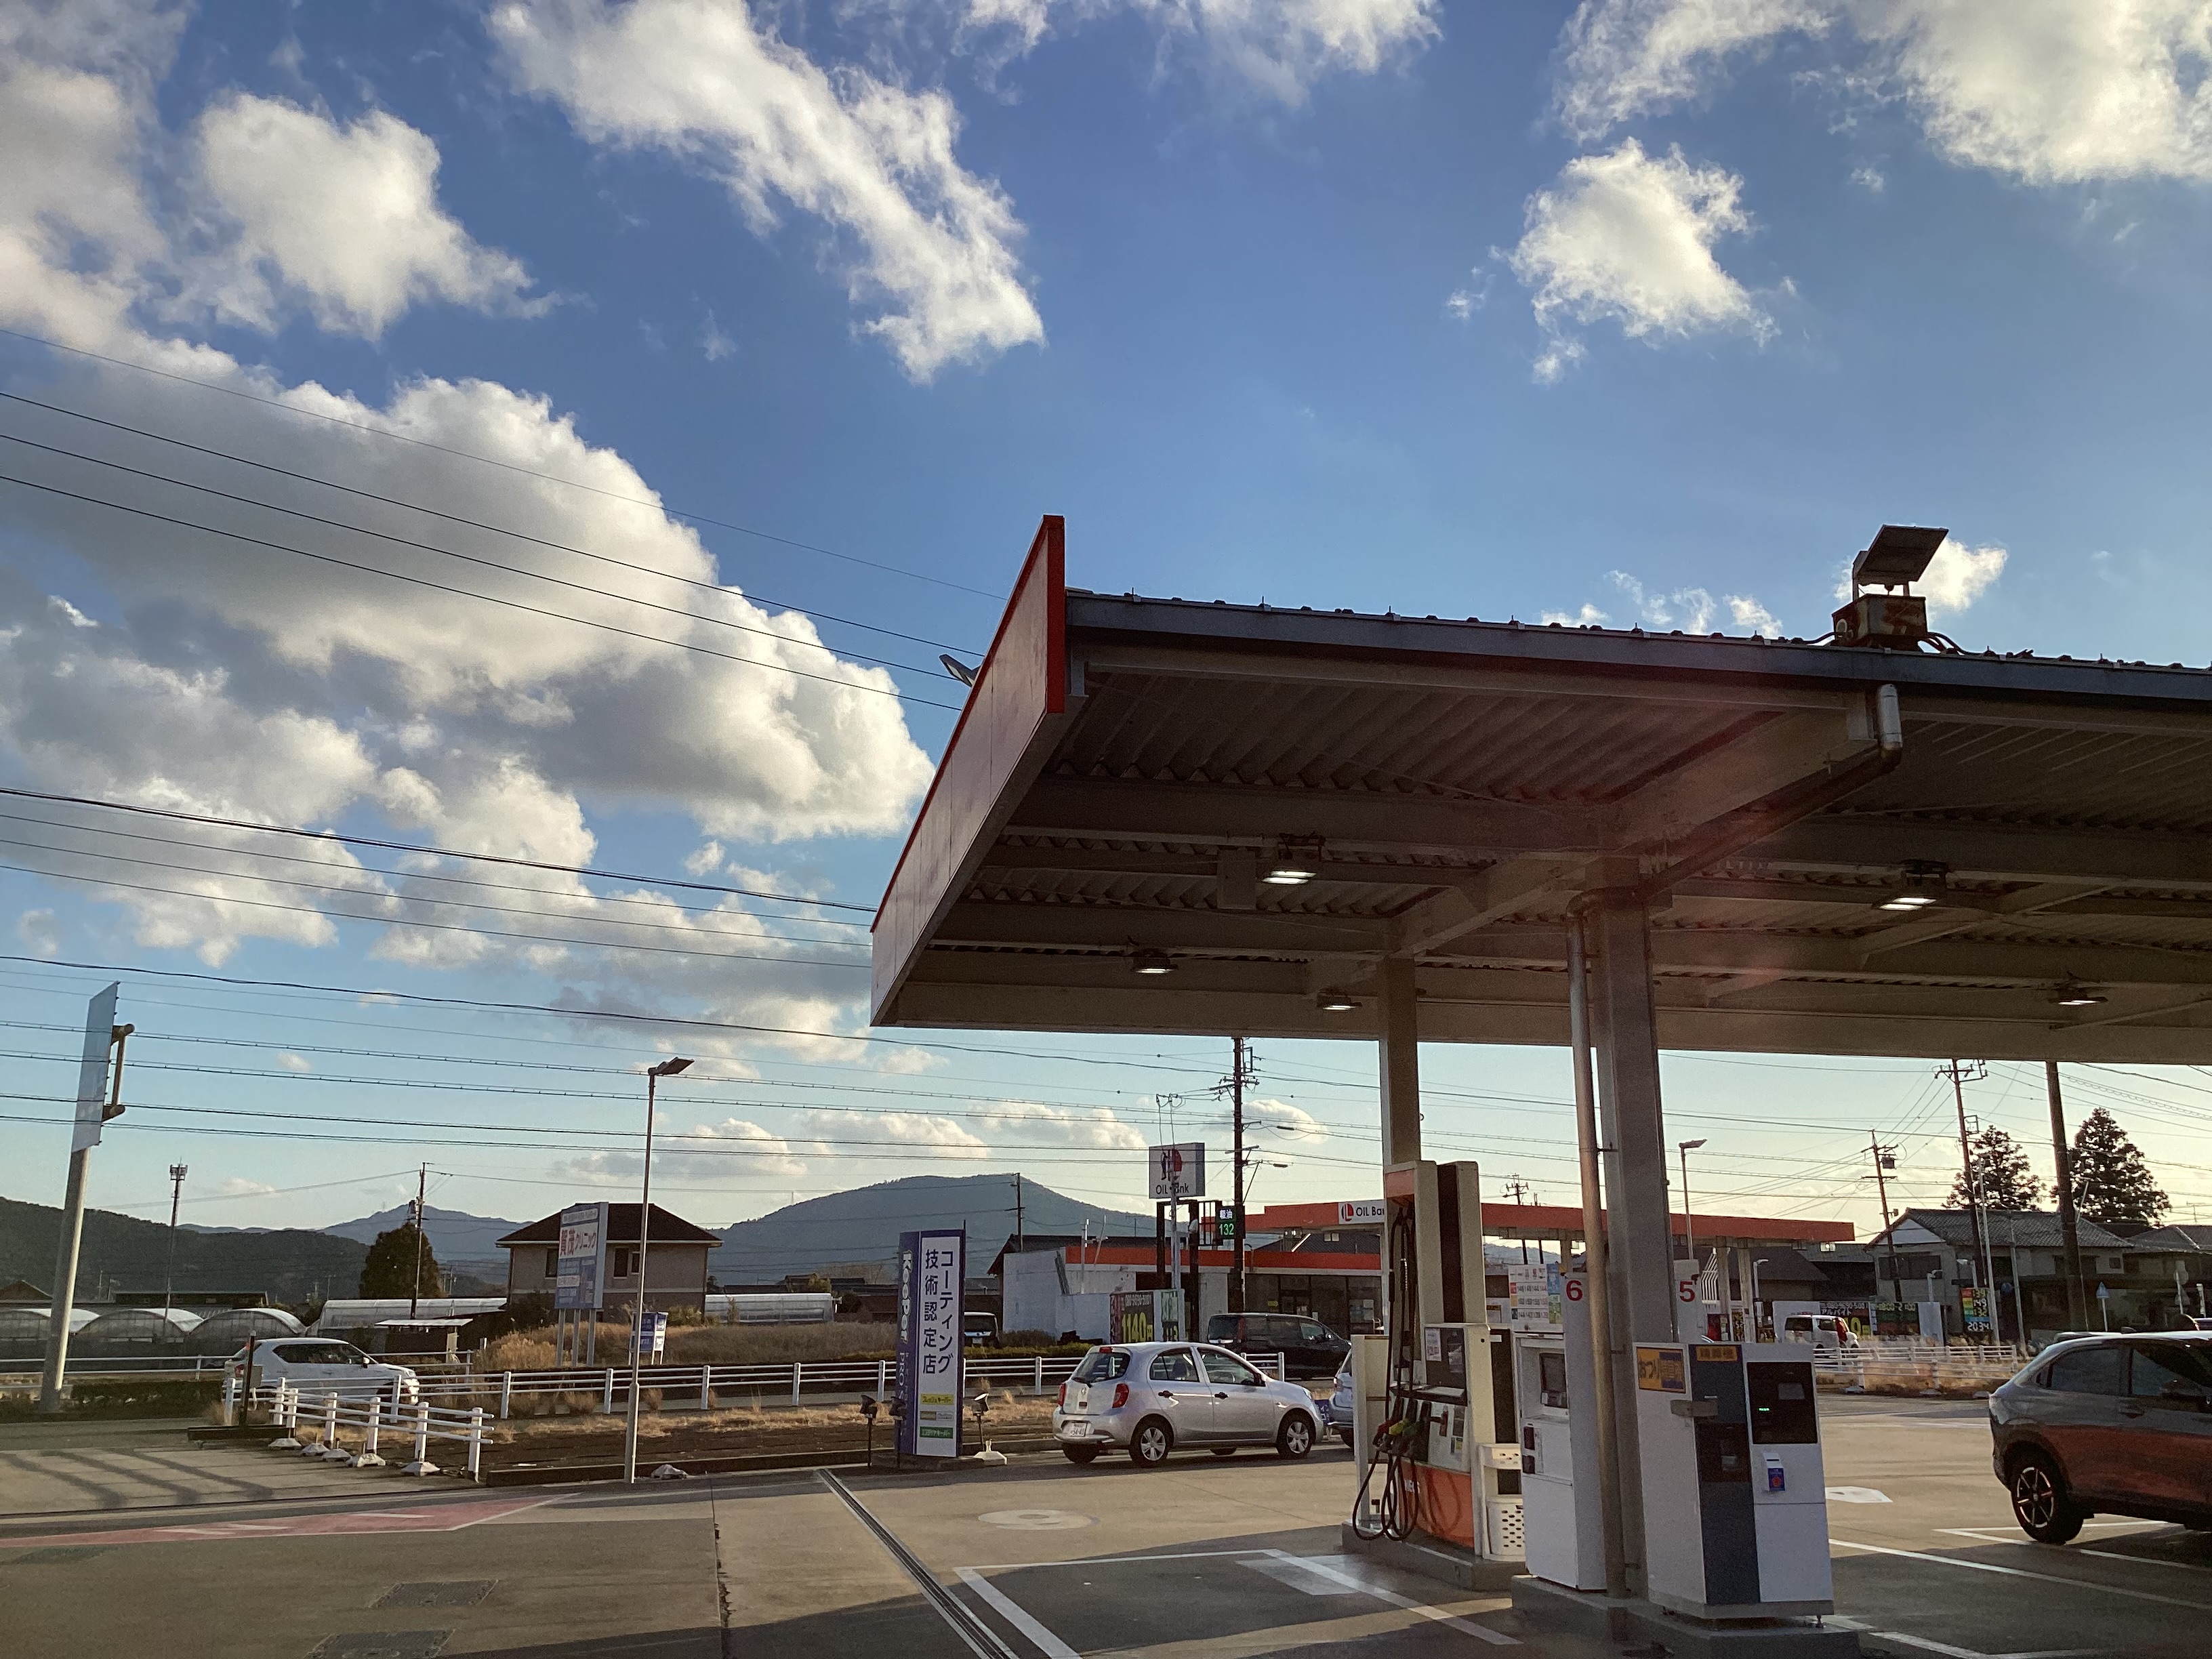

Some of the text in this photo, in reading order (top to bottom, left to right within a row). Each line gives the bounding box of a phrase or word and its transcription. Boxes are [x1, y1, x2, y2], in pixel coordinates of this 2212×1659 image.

[1155, 1185, 1168, 1195] OIL
[1356, 1207, 1369, 1216] OIL
[1219, 1223, 1234, 1235] 132
[1566, 1279, 1583, 1301] 6
[1679, 1281, 1695, 1302] 5
[922, 1249, 939, 1374] 技術認定店
[939, 1251, 954, 1374] コーティング
[1967, 1322, 1989, 1332] 2034
